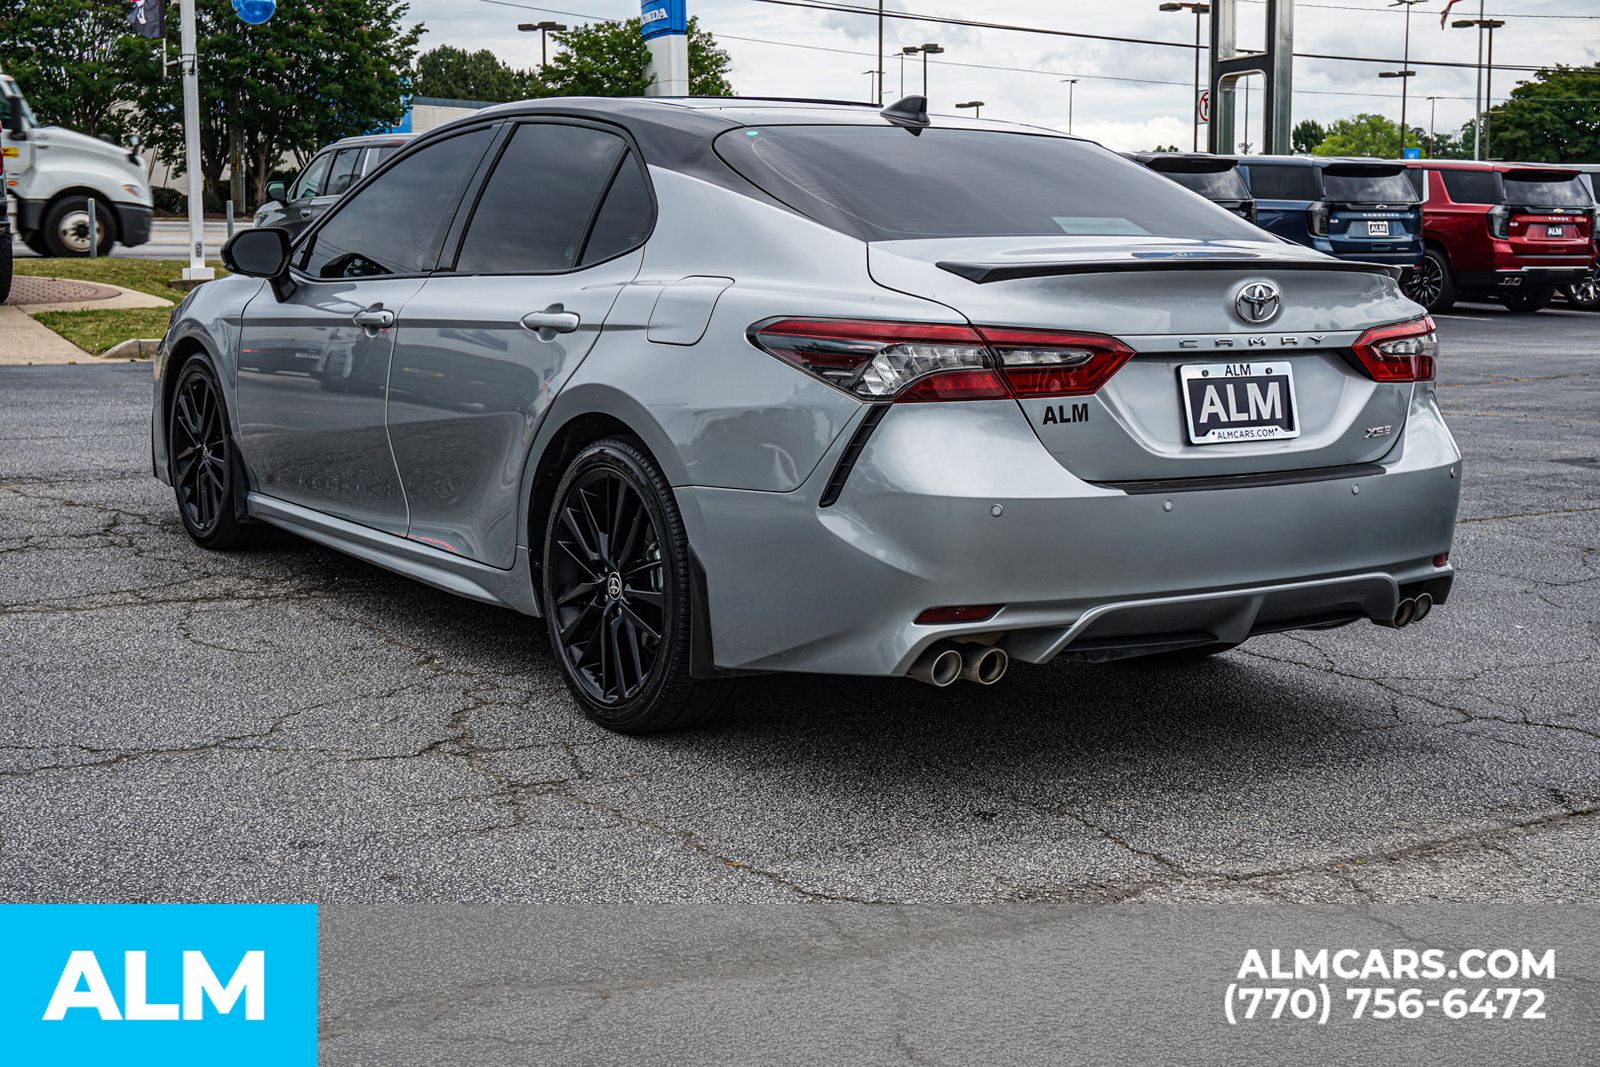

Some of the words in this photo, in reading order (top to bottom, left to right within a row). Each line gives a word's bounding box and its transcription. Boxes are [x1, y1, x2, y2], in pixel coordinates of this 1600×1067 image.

[1370, 224, 1386, 232] ALM
[1548, 227, 1563, 235] ALM
[1179, 336, 1326, 348] CAMRY
[1225, 364, 1252, 376] ALM
[1199, 382, 1282, 423] ALM
[1042, 403, 1089, 425] ALM
[1217, 428, 1275, 440] ALMCARS.COM
